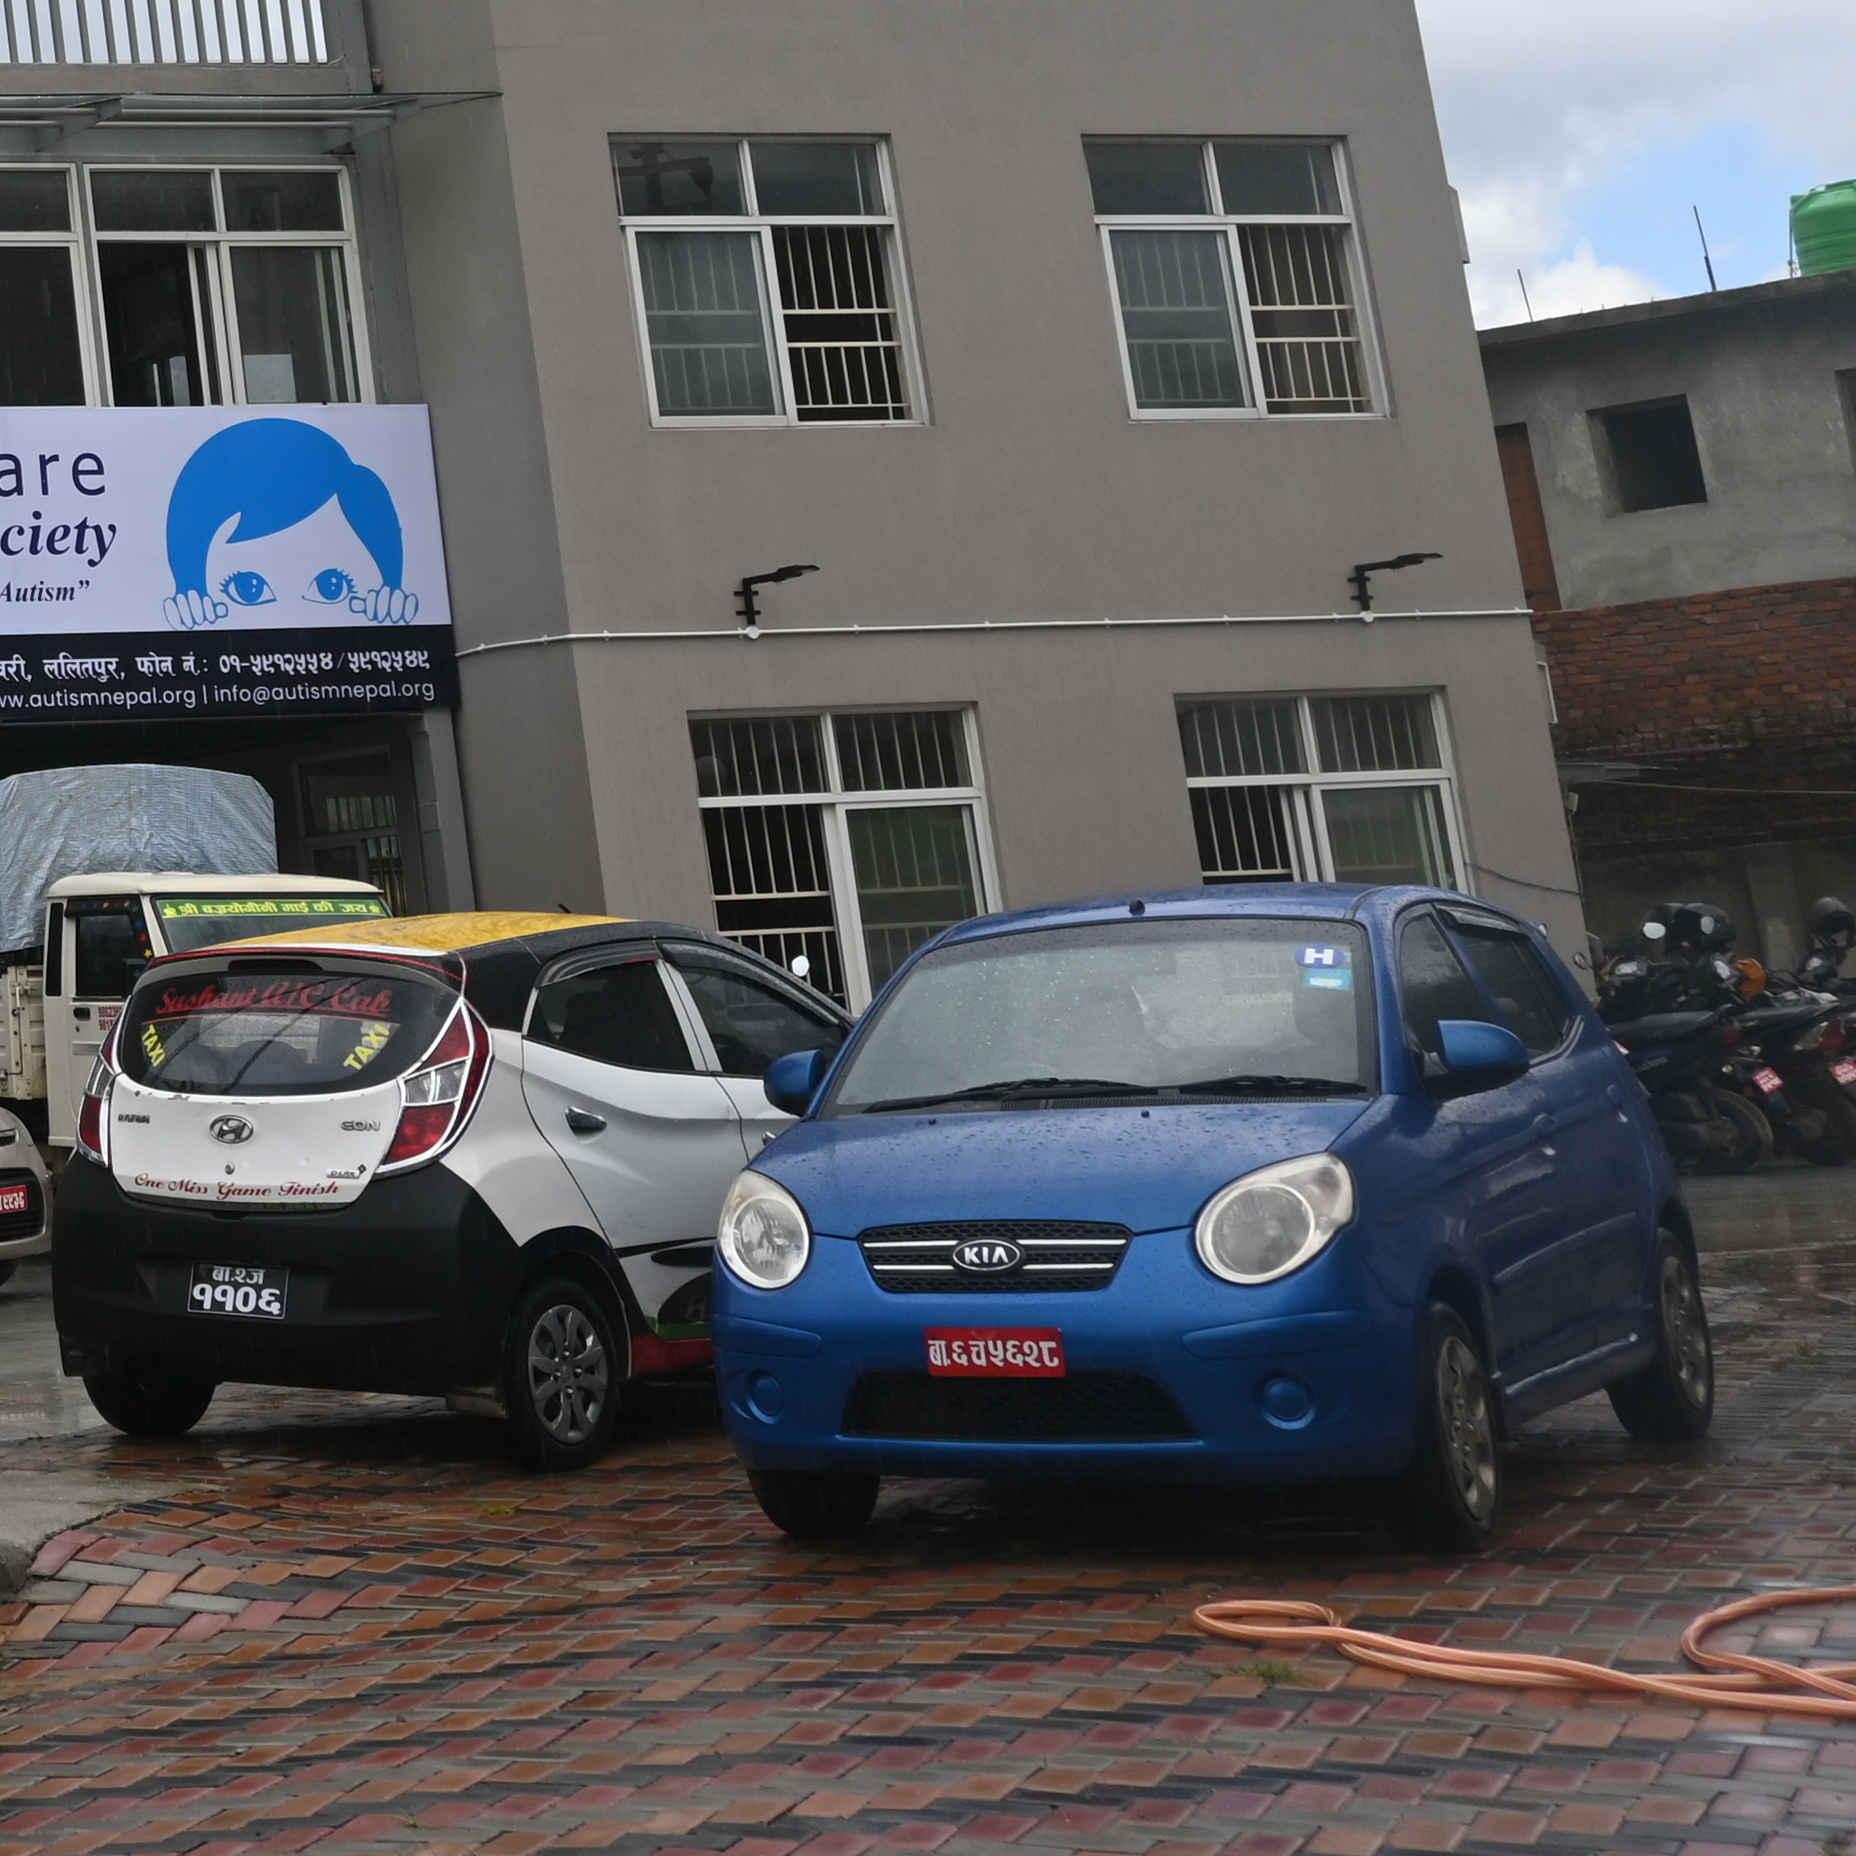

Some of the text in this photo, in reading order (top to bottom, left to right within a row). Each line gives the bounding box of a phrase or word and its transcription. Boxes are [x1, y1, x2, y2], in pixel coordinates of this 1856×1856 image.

[135, 651, 176, 678] फोन
[214, 680, 435, 706] info@autismnepal.org
[142, 1024, 166, 1067] TAXI
[343, 1023, 391, 1071] TAXI
[340, 1120, 381, 1132] EON
[964, 1246, 1009, 1264] KIA
[192, 1283, 282, 1315] ११०६
